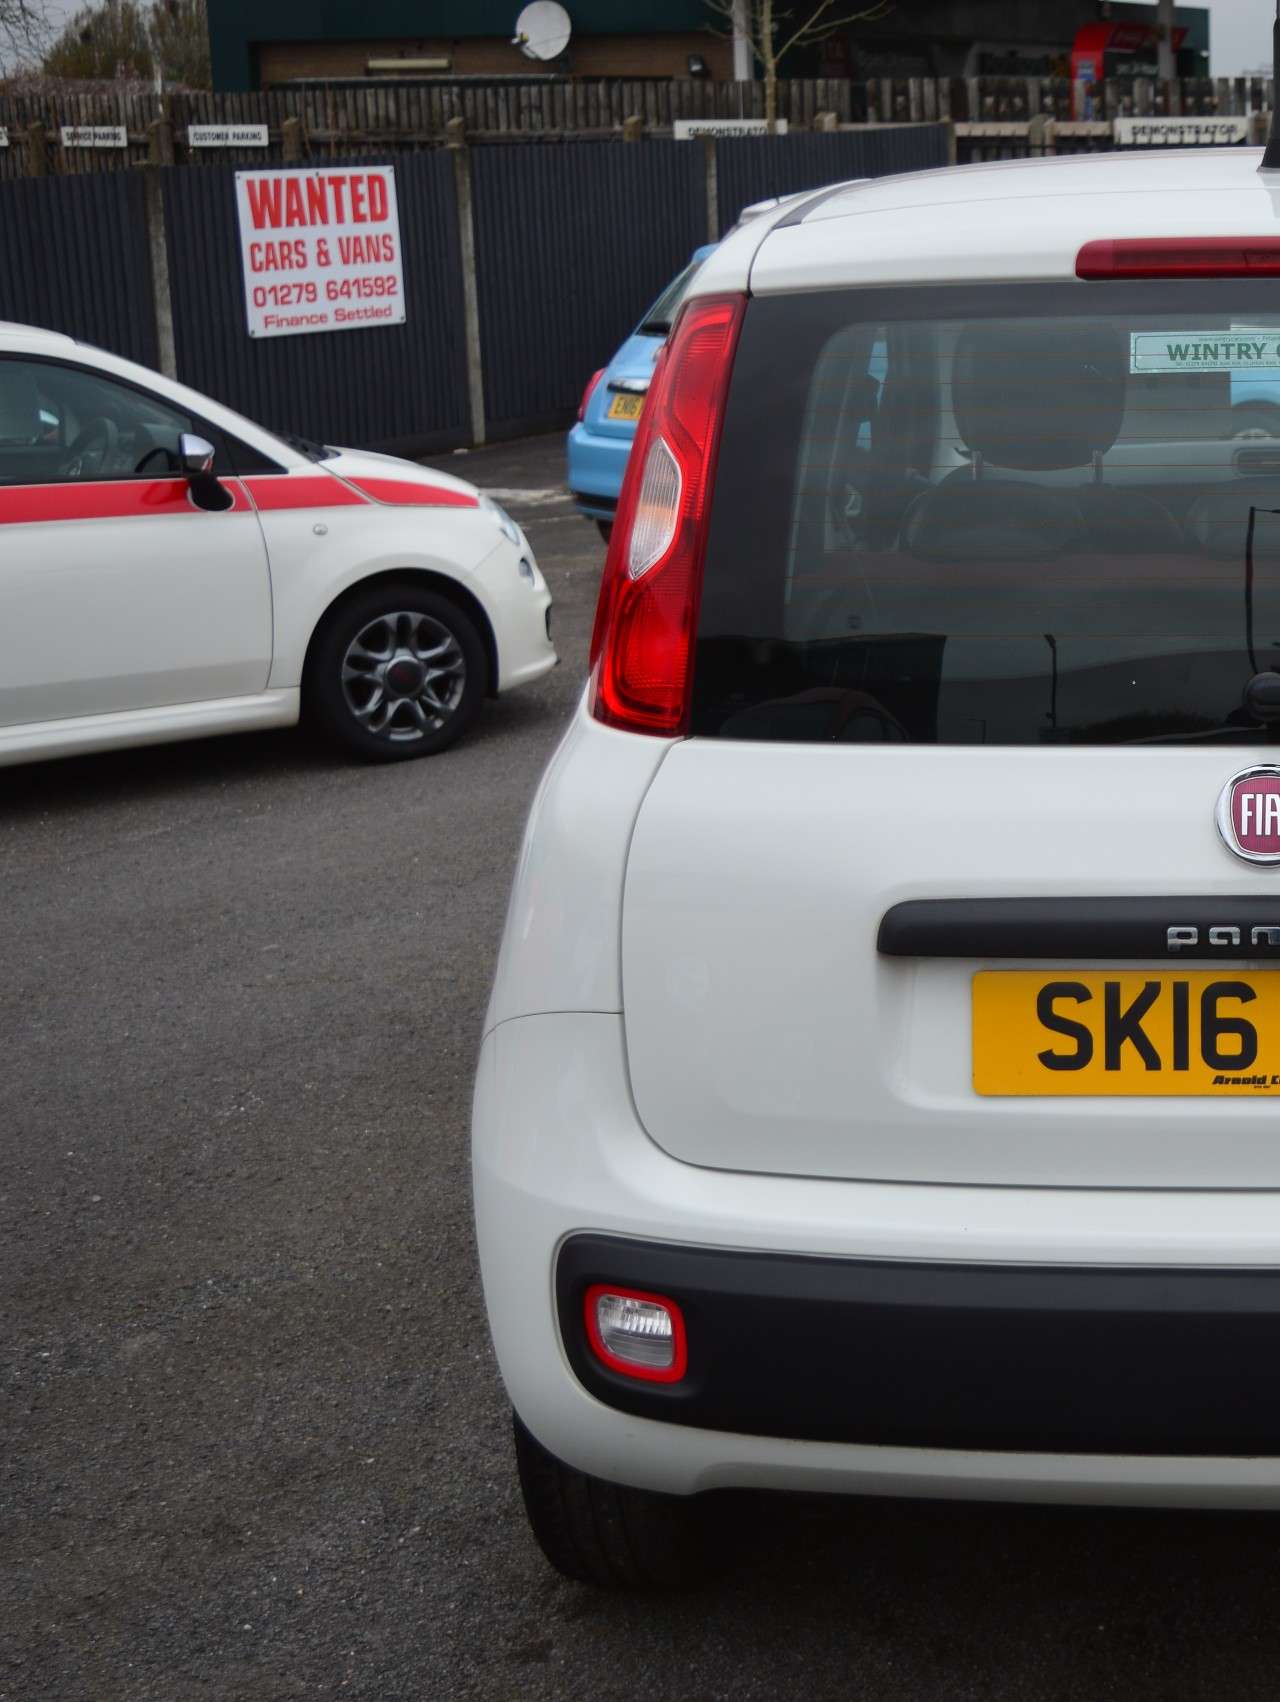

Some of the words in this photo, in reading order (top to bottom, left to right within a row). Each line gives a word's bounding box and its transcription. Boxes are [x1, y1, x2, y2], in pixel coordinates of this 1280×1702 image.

[193, 132, 229, 141] CUSTOMER
[232, 132, 262, 141] PARKING
[688, 126, 768, 137] DEMONSTRATO
[1131, 124, 1238, 136] DEMONSTRATOR
[246, 174, 389, 230] WANTED
[250, 239, 307, 272] CARS
[316, 237, 331, 267] &
[338, 233, 394, 265] VANS
[253, 282, 317, 307] 01279
[326, 275, 397, 301] 641592
[264, 312, 328, 329] Finance
[334, 304, 392, 322] Settled
[1166, 342, 1268, 361] WINTRY
[1036, 981, 1258, 1071] SK16
[1212, 1075, 1267, 1085] Arnold
